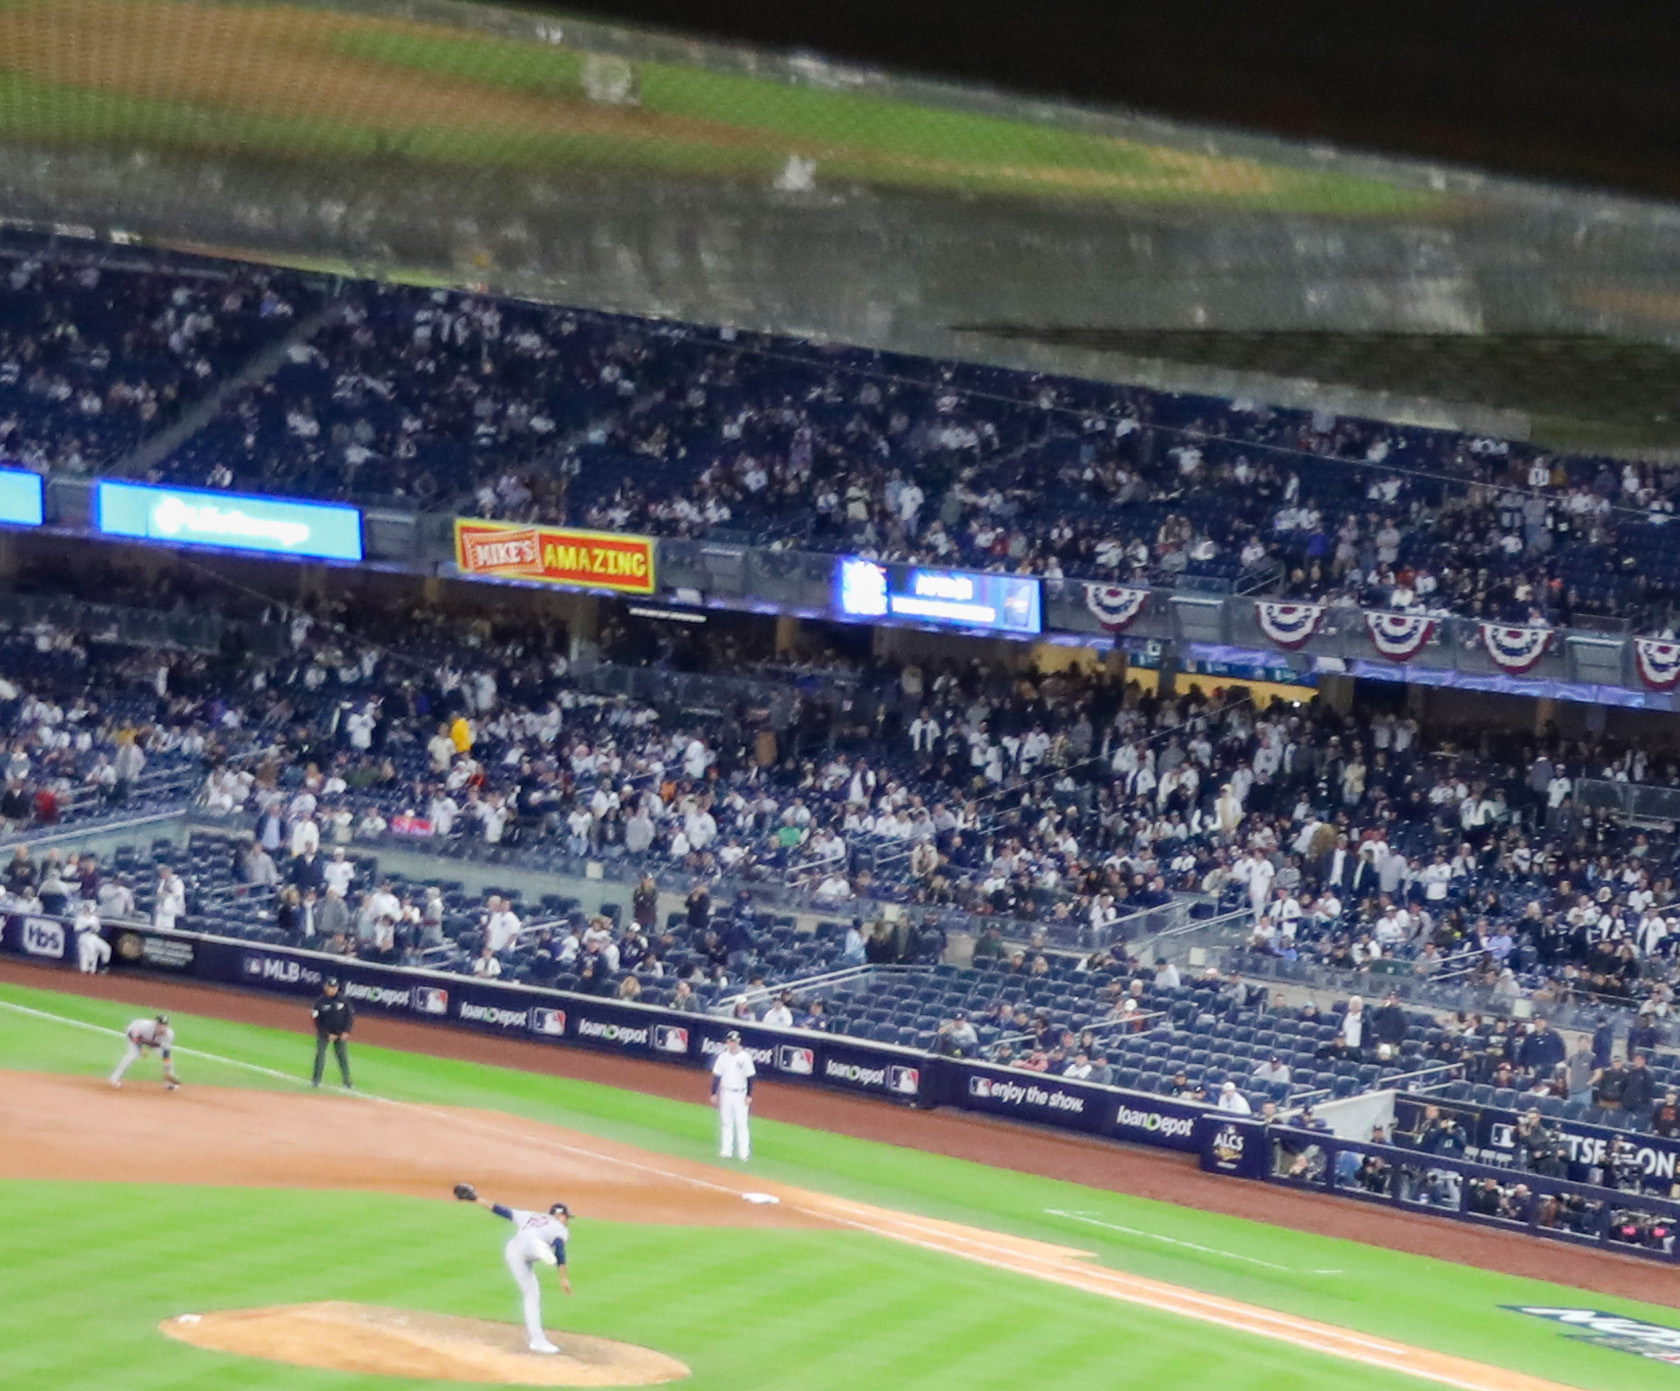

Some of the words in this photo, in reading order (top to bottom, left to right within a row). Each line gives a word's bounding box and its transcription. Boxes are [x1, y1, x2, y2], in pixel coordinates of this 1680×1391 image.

[476, 541, 534, 566] MIKE'S
[543, 544, 647, 577] AMAZING
[263, 957, 299, 981] MLB
[344, 980, 410, 1006] loanDepot
[460, 1001, 527, 1028] loanDepot
[578, 1016, 648, 1045] loanDepot
[701, 1037, 773, 1065] loapot
[825, 1058, 886, 1087] loanDepot
[991, 1081, 1026, 1105] enjoy
[1026, 1085, 1048, 1106] the
[1117, 1104, 1194, 1137] loanDepot
[1213, 1132, 1244, 1152] ALCS
